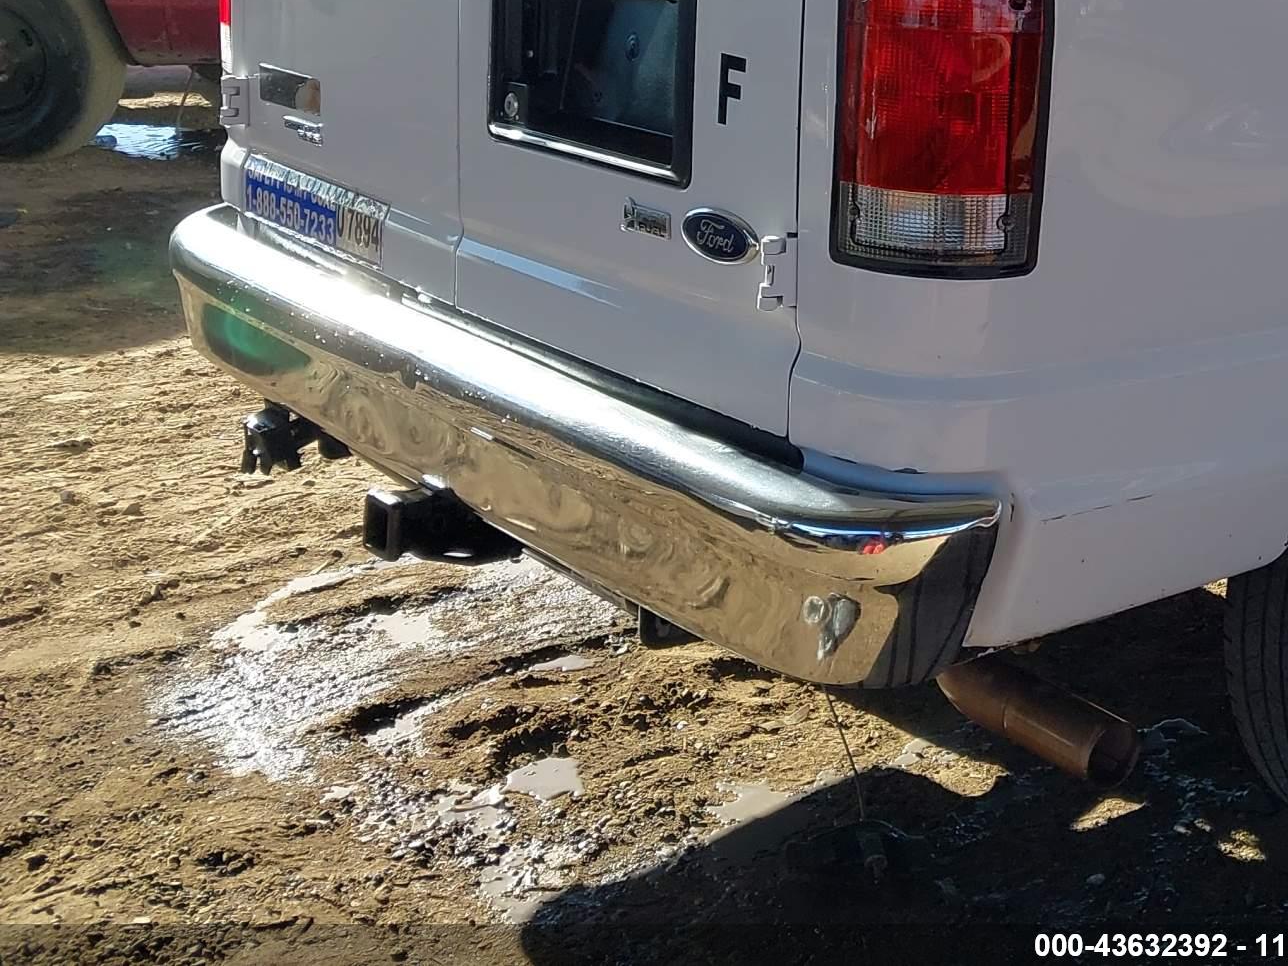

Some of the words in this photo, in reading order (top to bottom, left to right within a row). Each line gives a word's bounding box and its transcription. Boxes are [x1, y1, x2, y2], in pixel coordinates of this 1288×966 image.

[718, 52, 747, 125] F
[247, 184, 335, 245] 1-888-550-7233
[696, 219, 734, 253] Ford
